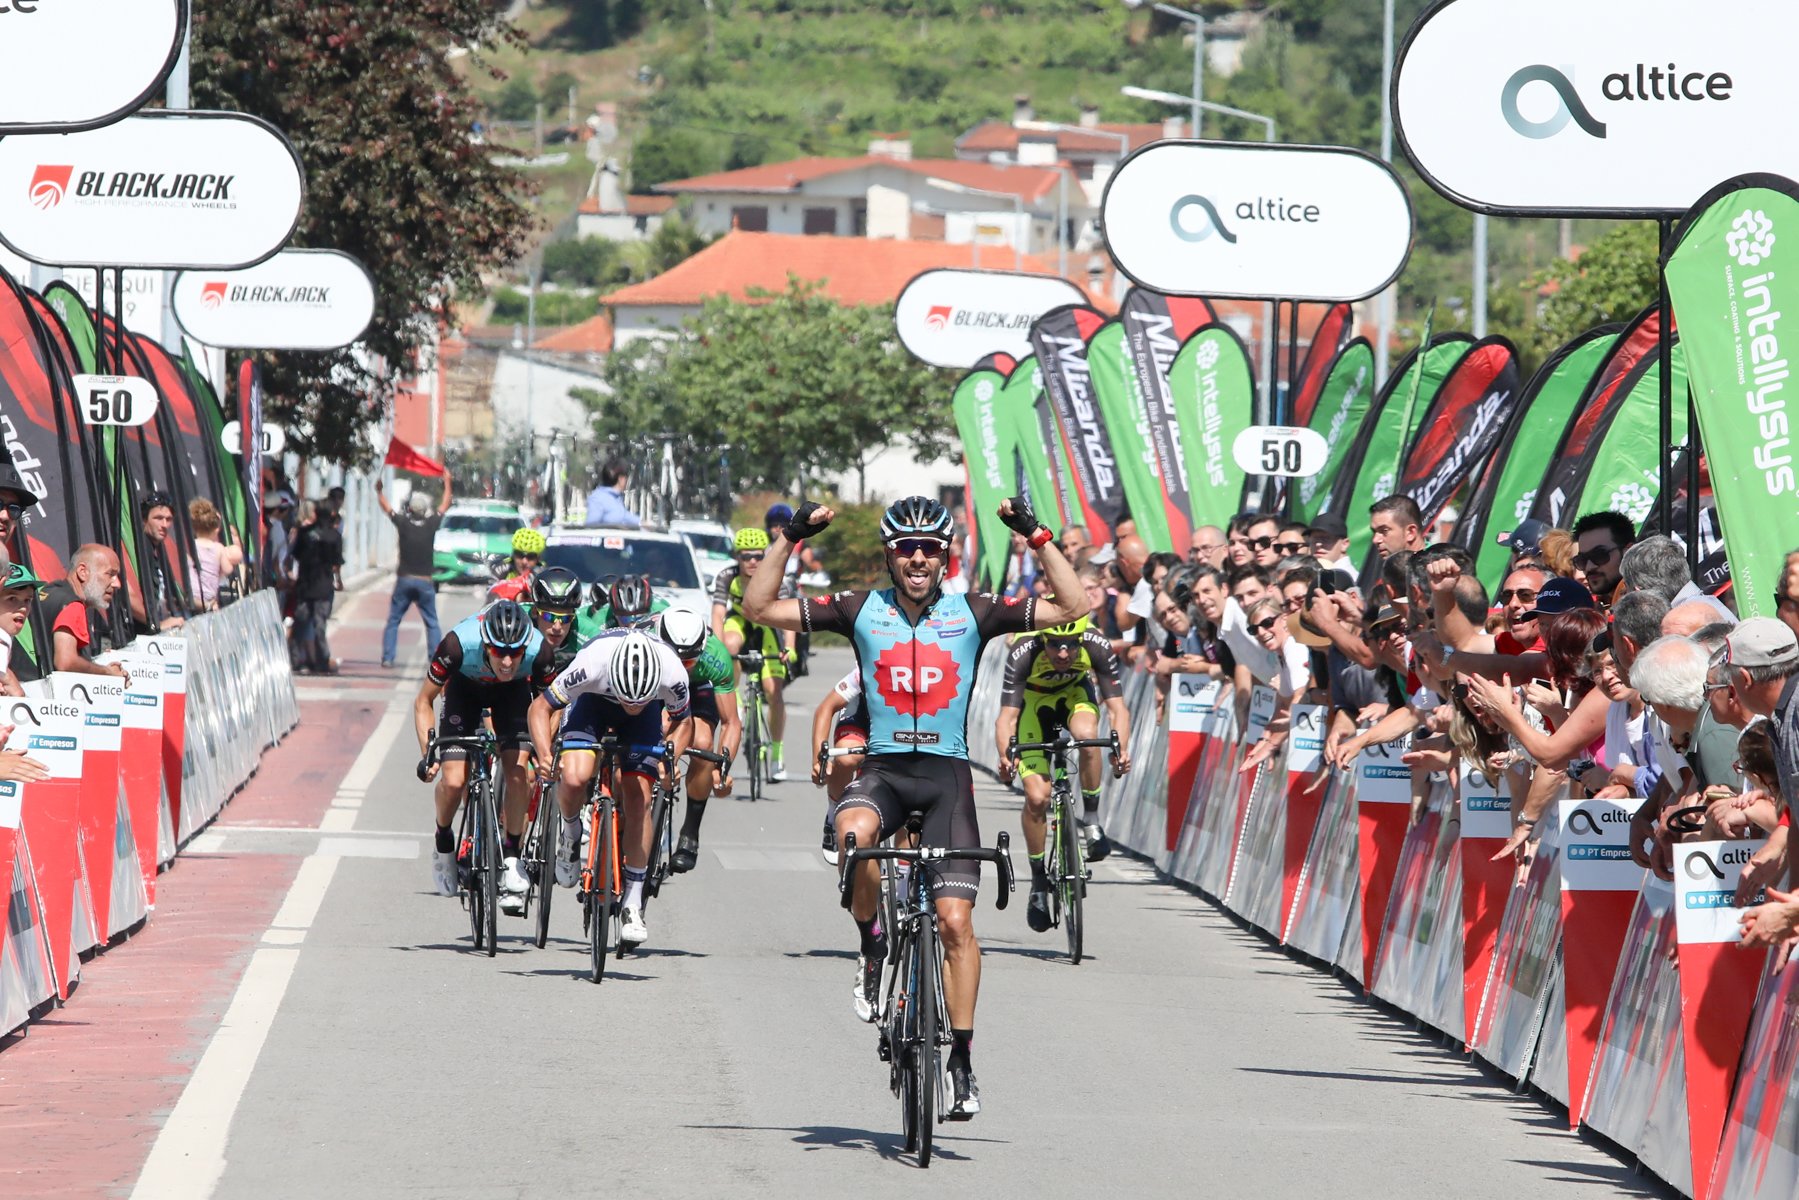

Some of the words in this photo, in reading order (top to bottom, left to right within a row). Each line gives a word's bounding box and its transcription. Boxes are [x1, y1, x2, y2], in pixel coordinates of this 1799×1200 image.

[1602, 62, 1733, 101] altice
[76, 171, 234, 200] BLACKJACK
[1236, 197, 1320, 223] altice
[231, 285, 329, 302] BLACKJACK
[954, 310, 1039, 329] BLACKJA
[1736, 343, 1746, 385] SOLUTIONS
[1742, 271, 1795, 496] intellysys
[90, 389, 132, 423] 50
[1040, 333, 1114, 500] Miranda
[1261, 439, 1301, 473] 50
[1407, 390, 1510, 512] iranda
[162, 642, 183, 651] altice
[1083, 631, 1110, 650] EFAPEL
[131, 668, 159, 679] altice
[564, 668, 587, 688] KTM
[890, 666, 943, 693] RP
[92, 684, 122, 696] altice
[40, 704, 79, 718] altice
[91, 716, 119, 726] Empresas
[39, 738, 74, 748] Empresas
[1388, 736, 1412, 750] altic
[1378, 768, 1386, 776] PT
[1482, 801, 1492, 809] PT
[1601, 809, 1635, 824] altic
[1588, 848, 1598, 857] PT
[1601, 848, 1631, 859] Empres
[1722, 848, 1751, 865] alti
[1709, 895, 1721, 904] PT
